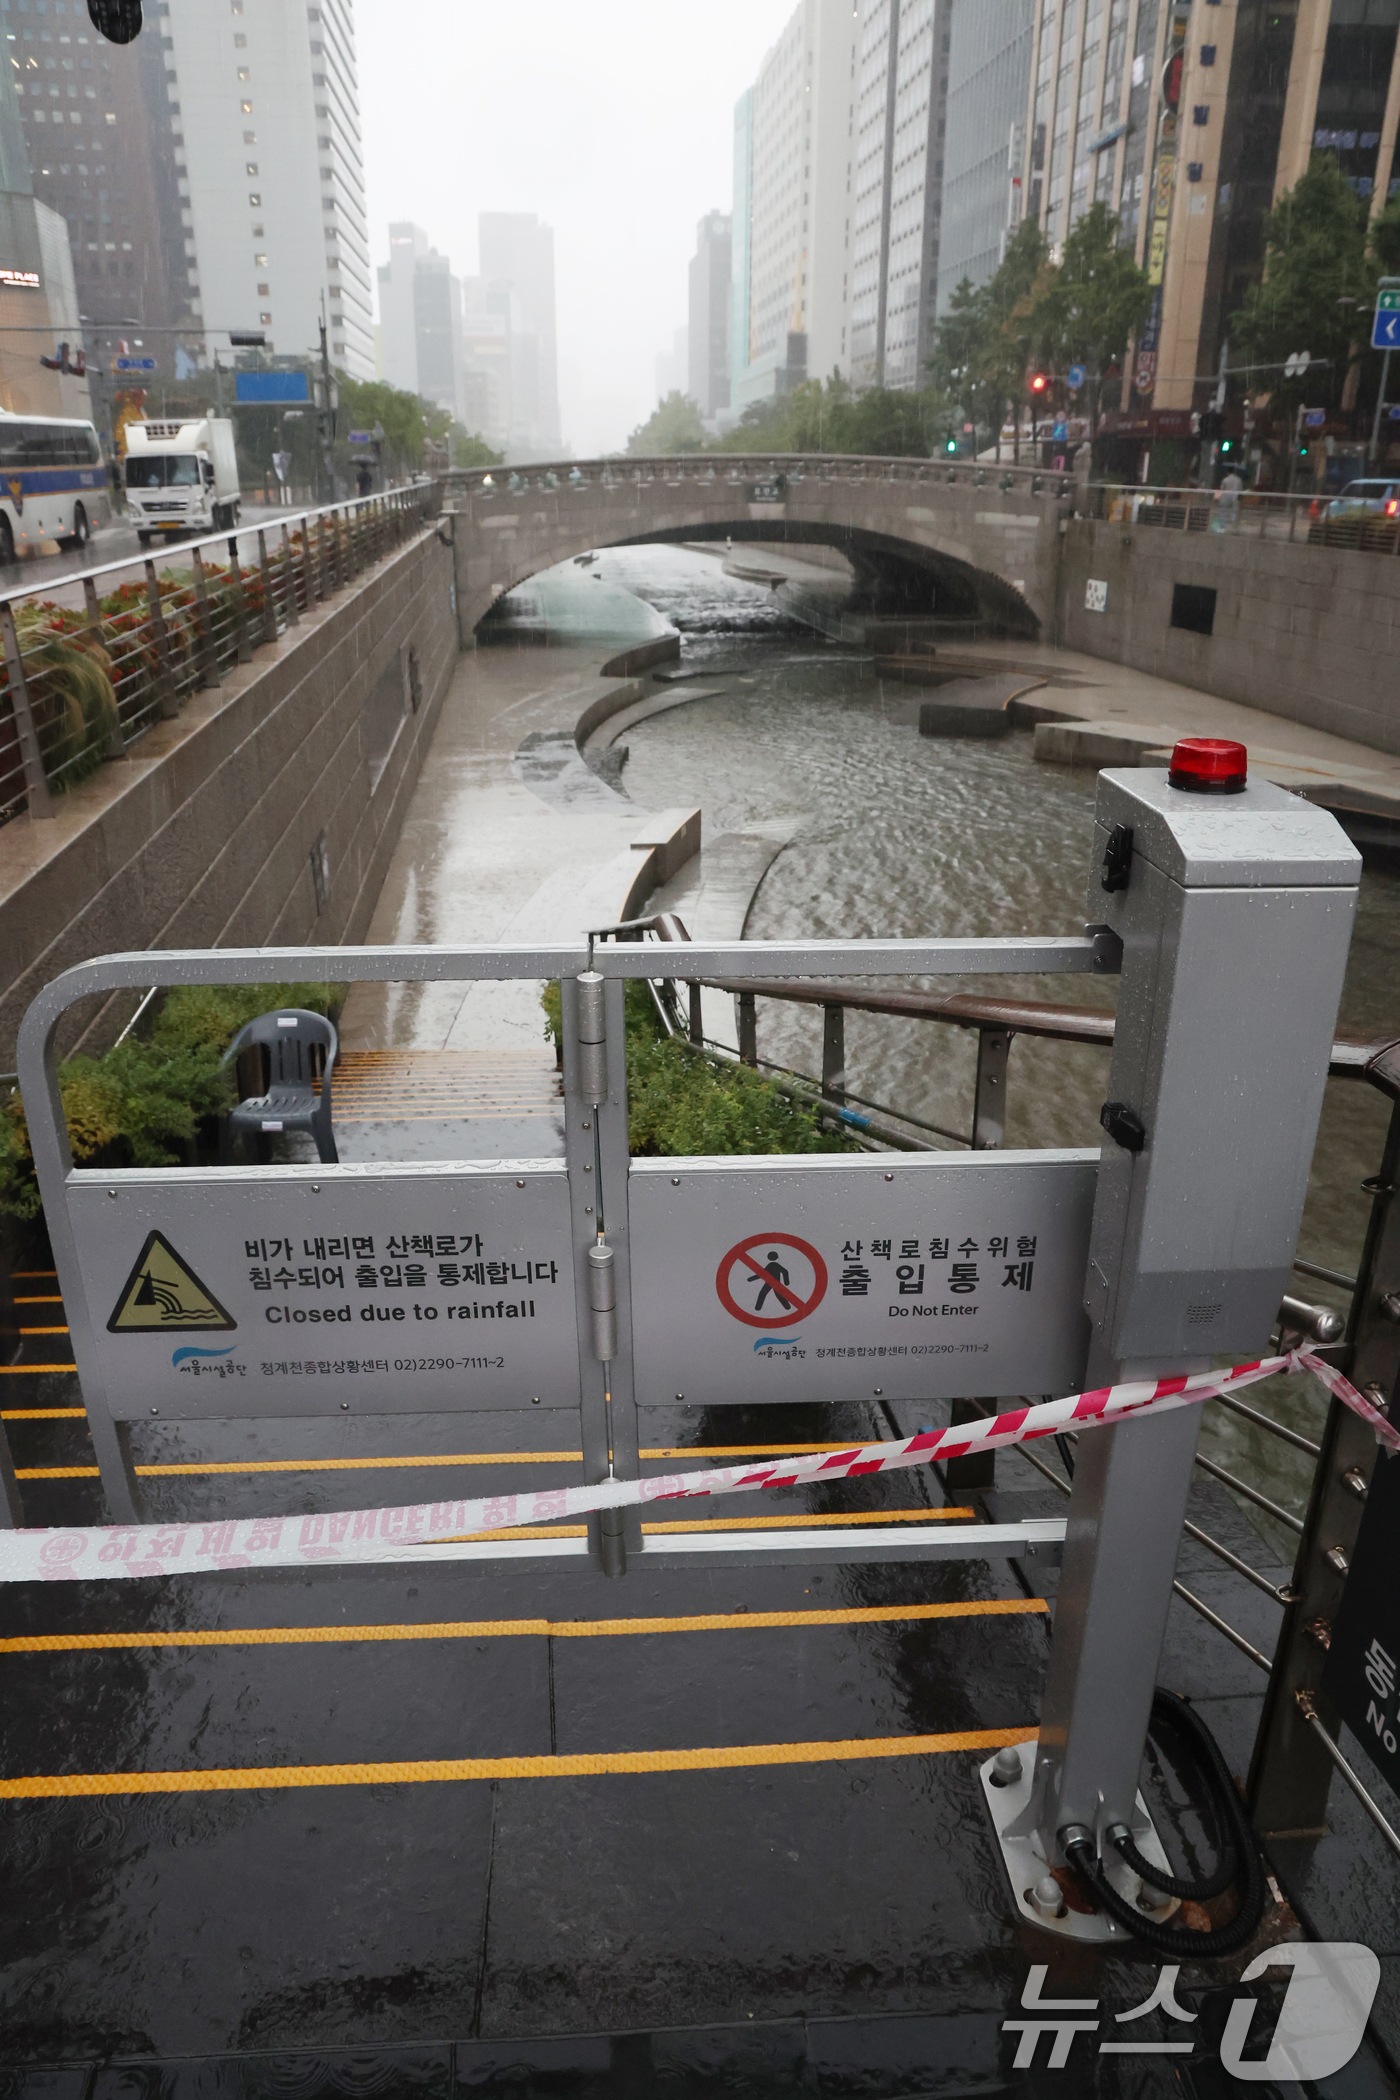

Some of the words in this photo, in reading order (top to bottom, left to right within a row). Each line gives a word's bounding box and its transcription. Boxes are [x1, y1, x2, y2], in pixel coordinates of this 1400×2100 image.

[245, 1238, 293, 1261] 비가
[303, 1236, 375, 1260] 내리면
[386, 1234, 483, 1258] 산책로가
[249, 1266, 344, 1290] 침수되어
[355, 1264, 427, 1288] 출입을
[437, 1261, 558, 1286] 통제합니다
[265, 1305, 351, 1323] Closed
[360, 1304, 405, 1321] due
[413, 1304, 438, 1320] to
[448, 1300, 534, 1319] rainfall
[889, 1306, 909, 1317] Do
[912, 1304, 938, 1317] Not
[941, 1303, 979, 1316] Enter
[758, 1345, 806, 1360] 서울시설공단
[816, 1346, 907, 1358] 청계천종합상황센터
[911, 1344, 989, 1355] 02)2290-7111~2
[180, 1359, 247, 1378] 서울시설공단
[260, 1359, 388, 1375] 청계천종합상황센터
[394, 1357, 504, 1372] 02)2290-7111~2
